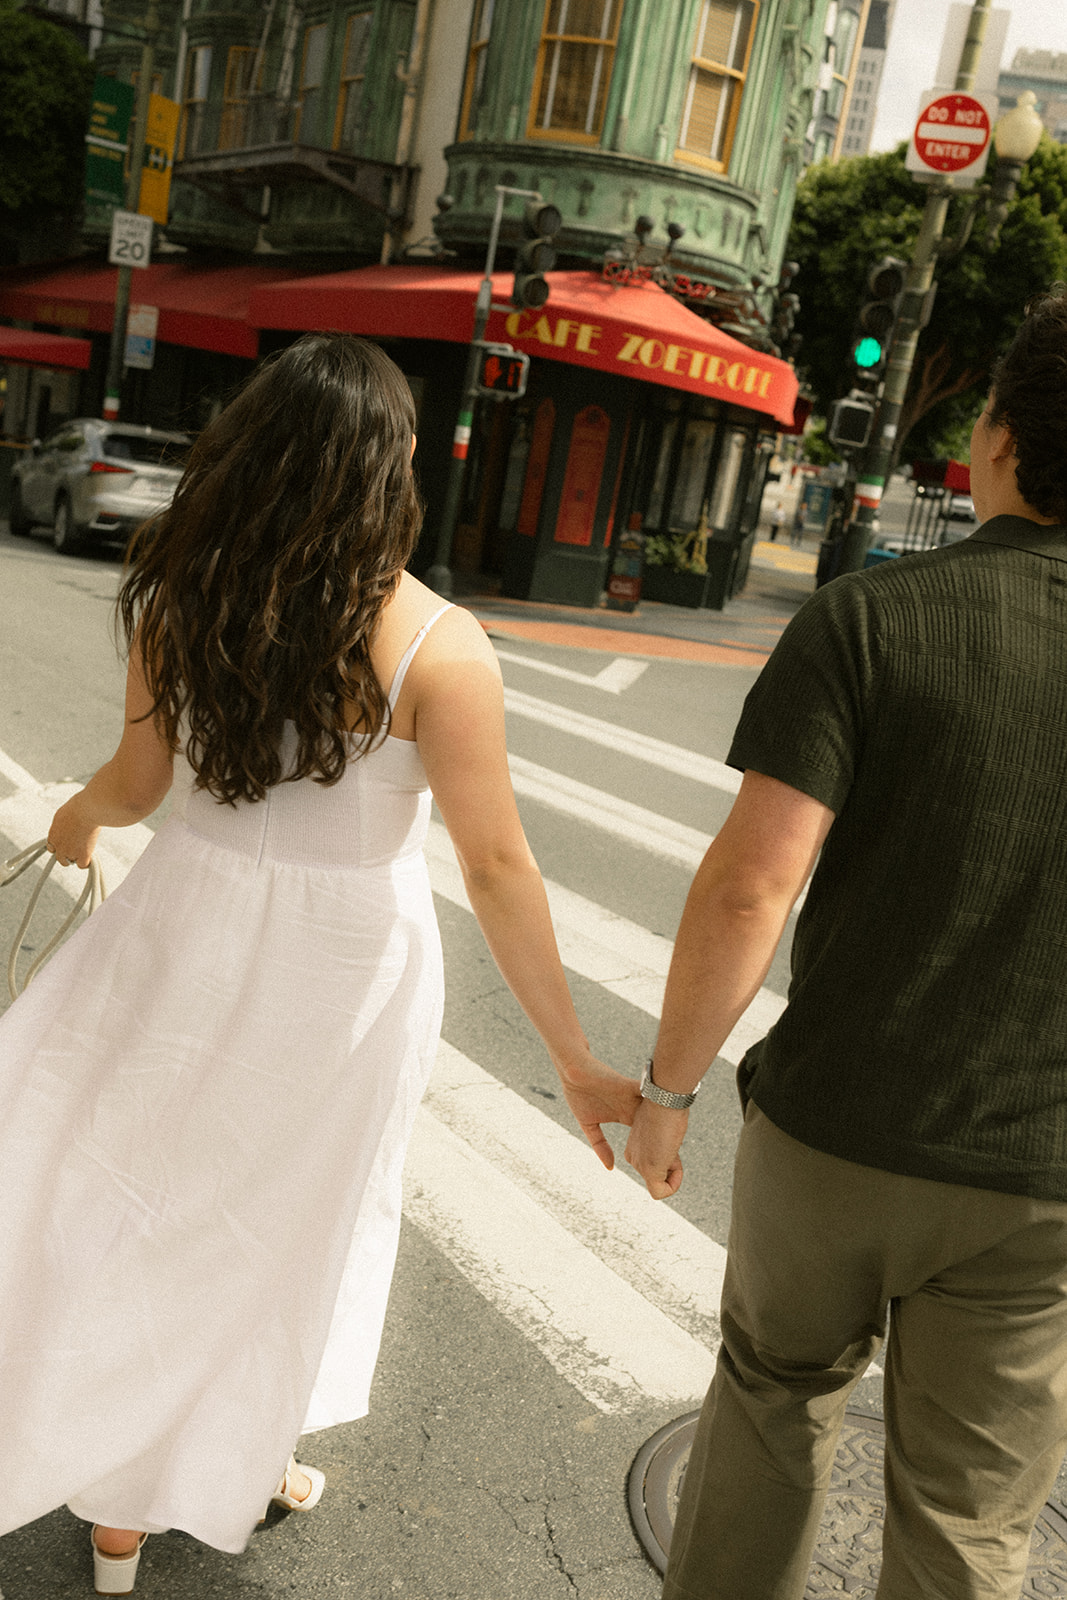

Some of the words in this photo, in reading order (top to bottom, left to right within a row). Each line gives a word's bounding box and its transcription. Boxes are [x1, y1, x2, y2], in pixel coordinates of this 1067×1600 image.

[927, 106, 949, 122] DO
[954, 109, 984, 125] NOT
[925, 141, 971, 160] ENTER
[115, 239, 144, 260] 20
[505, 312, 602, 355] CAFE
